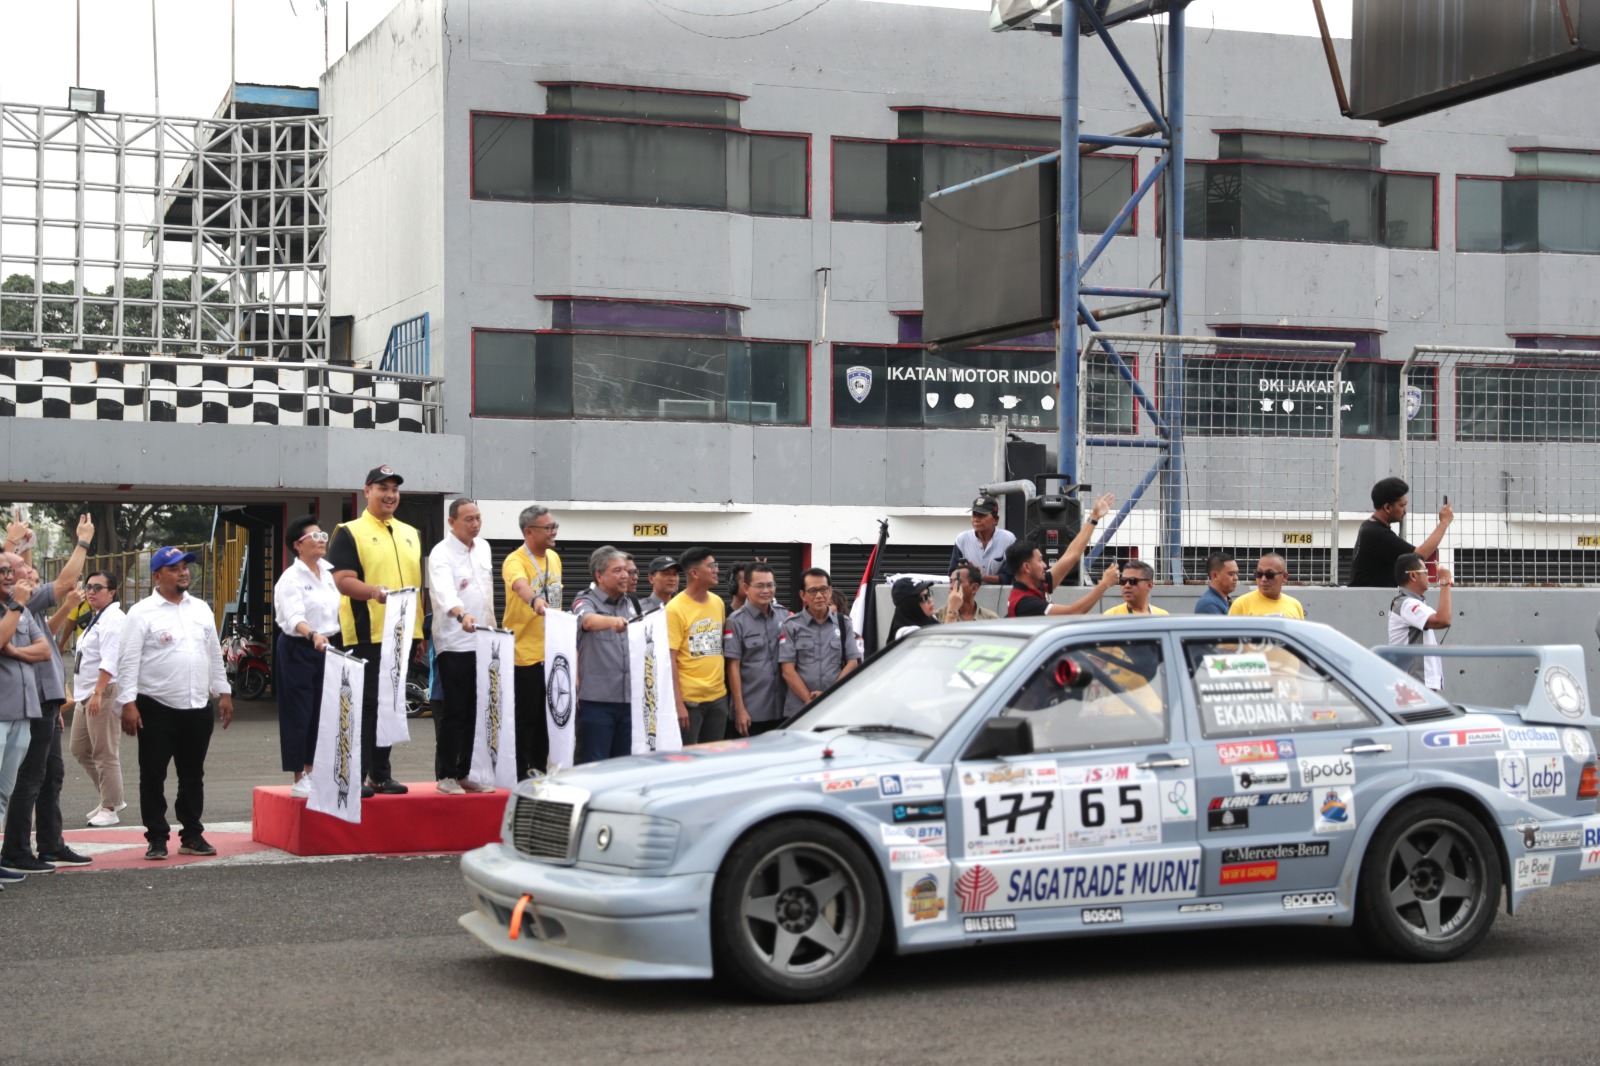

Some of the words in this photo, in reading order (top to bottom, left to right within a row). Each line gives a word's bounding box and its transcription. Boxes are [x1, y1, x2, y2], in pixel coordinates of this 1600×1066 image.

[887, 366, 947, 382] IKATAN
[951, 368, 1010, 384] MOTOR
[1259, 378, 1284, 393] DKI
[1287, 379, 1356, 394] JAKARTA
[633, 525, 652, 535] PIT
[653, 525, 668, 536] 50
[1283, 533, 1299, 544] PIT
[1299, 534, 1312, 544] 48
[1577, 536, 1592, 546] PIT
[1592, 537, 1600, 546] 4
[1213, 702, 1288, 726] EKADANA
[1468, 733, 1501, 741] RADIAL
[1532, 764, 1563, 794] abp
[974, 790, 1055, 836] 177
[918, 827, 943, 837] BTN
[1236, 843, 1327, 861] Mercedes-Benz
[1007, 863, 1127, 903] SAGATRADE
[1131, 858, 1200, 895] MURNI
[1193, 903, 1223, 911] AMG
[1283, 892, 1335, 909] sparco
[964, 915, 1015, 931] BILSTEIN
[1082, 909, 1122, 923] BOSCH
